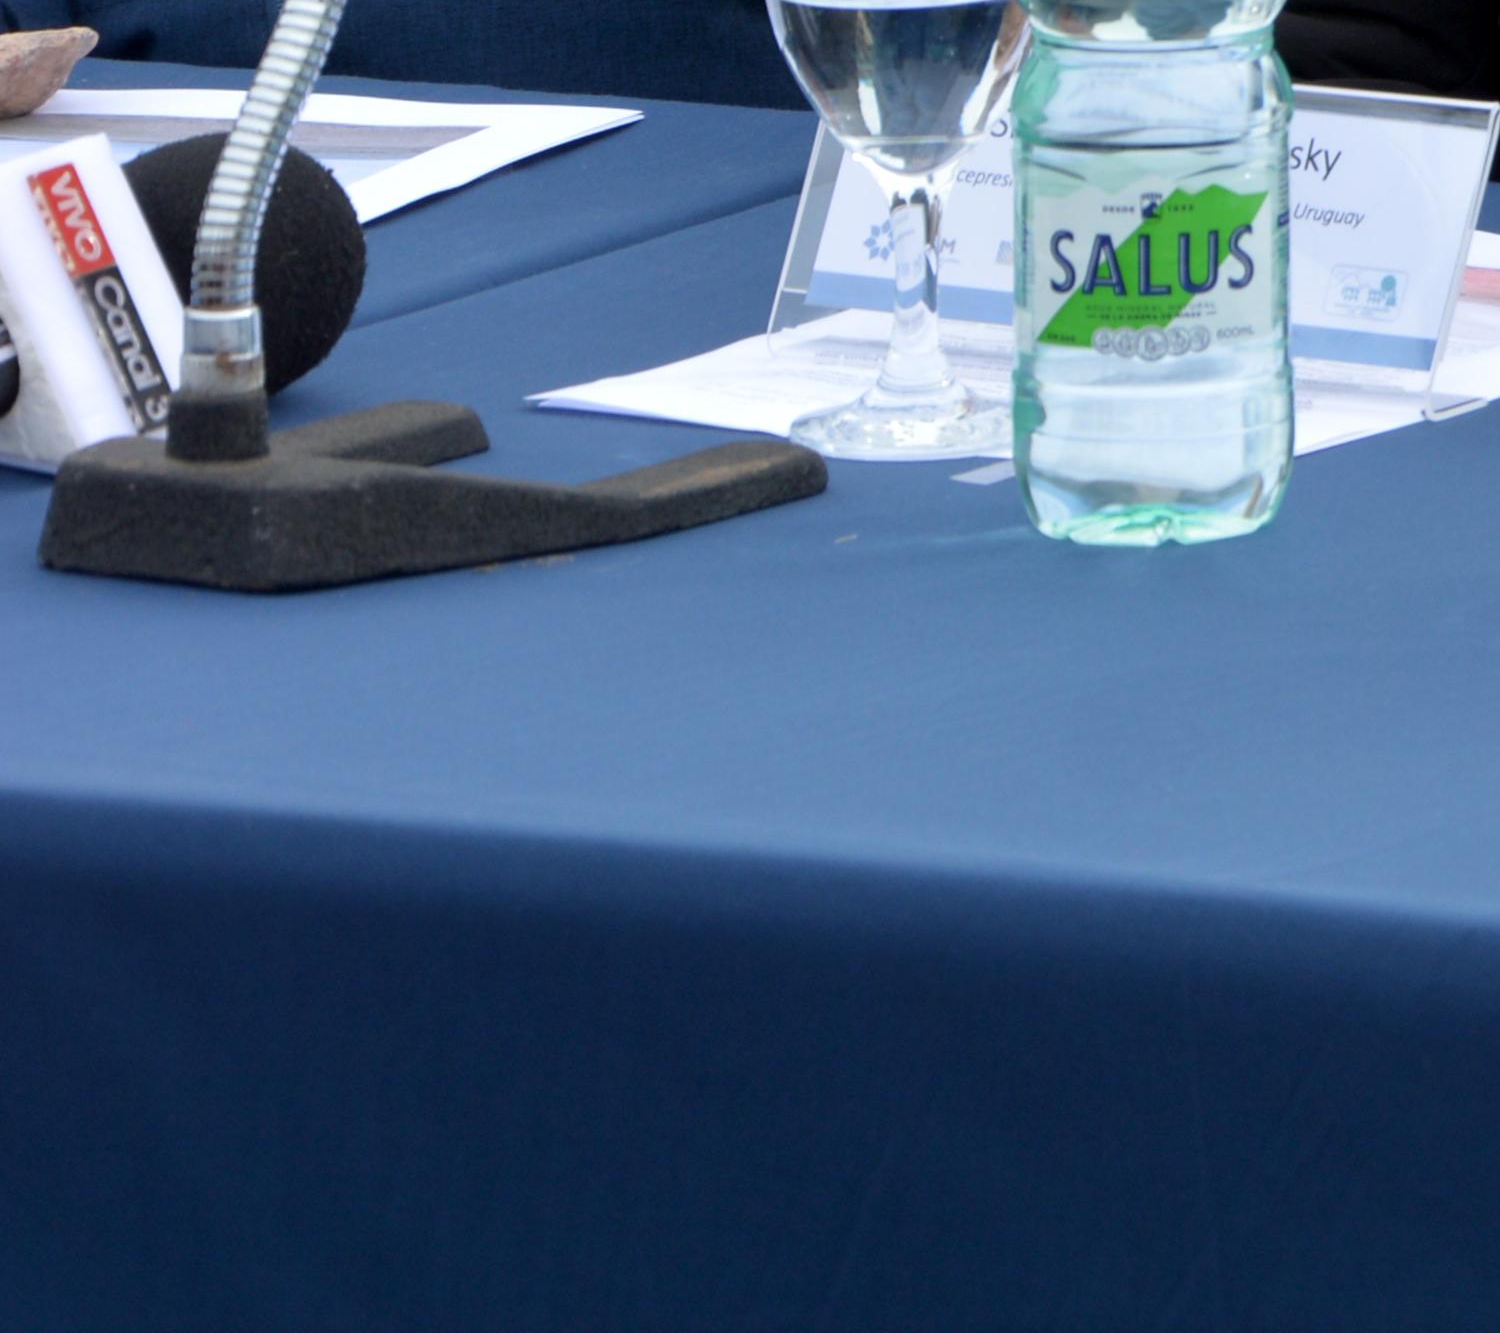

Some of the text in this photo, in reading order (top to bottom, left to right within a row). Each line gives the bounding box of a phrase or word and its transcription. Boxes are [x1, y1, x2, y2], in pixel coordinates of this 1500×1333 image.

[1290, 138, 1341, 181] sky
[1293, 202, 1365, 228] Uruguay
[1050, 224, 1255, 295] SALUS
[94, 276, 162, 390] Canal
